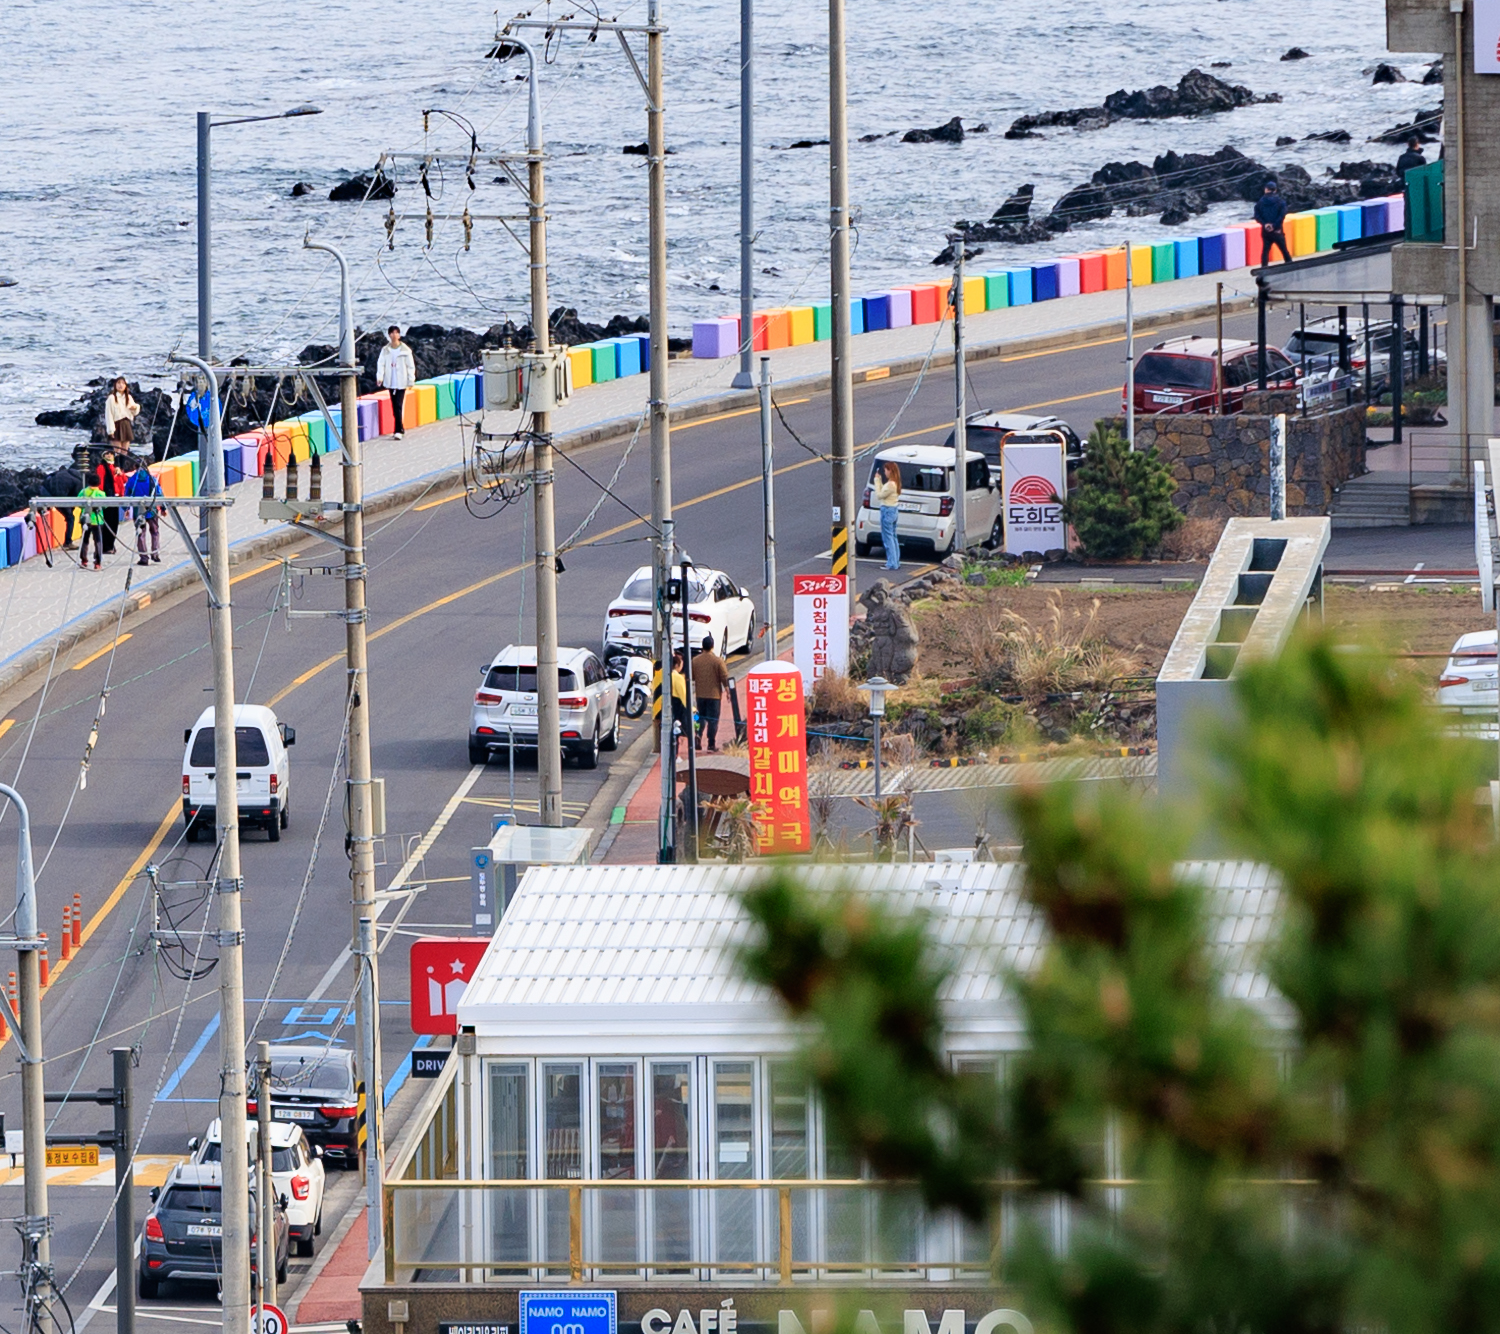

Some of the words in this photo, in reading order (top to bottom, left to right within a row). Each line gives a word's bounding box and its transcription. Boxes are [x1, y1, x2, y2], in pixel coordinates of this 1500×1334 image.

[1008, 506, 1061, 525] 도희도
[812, 597, 829, 690] 아침식사됩니
[748, 678, 773, 693] 제주
[753, 696, 769, 744] 고사리
[776, 677, 803, 846] 성게미역국
[529, 1307, 564, 1318] NAMO
[571, 1307, 606, 1318] NAMO
